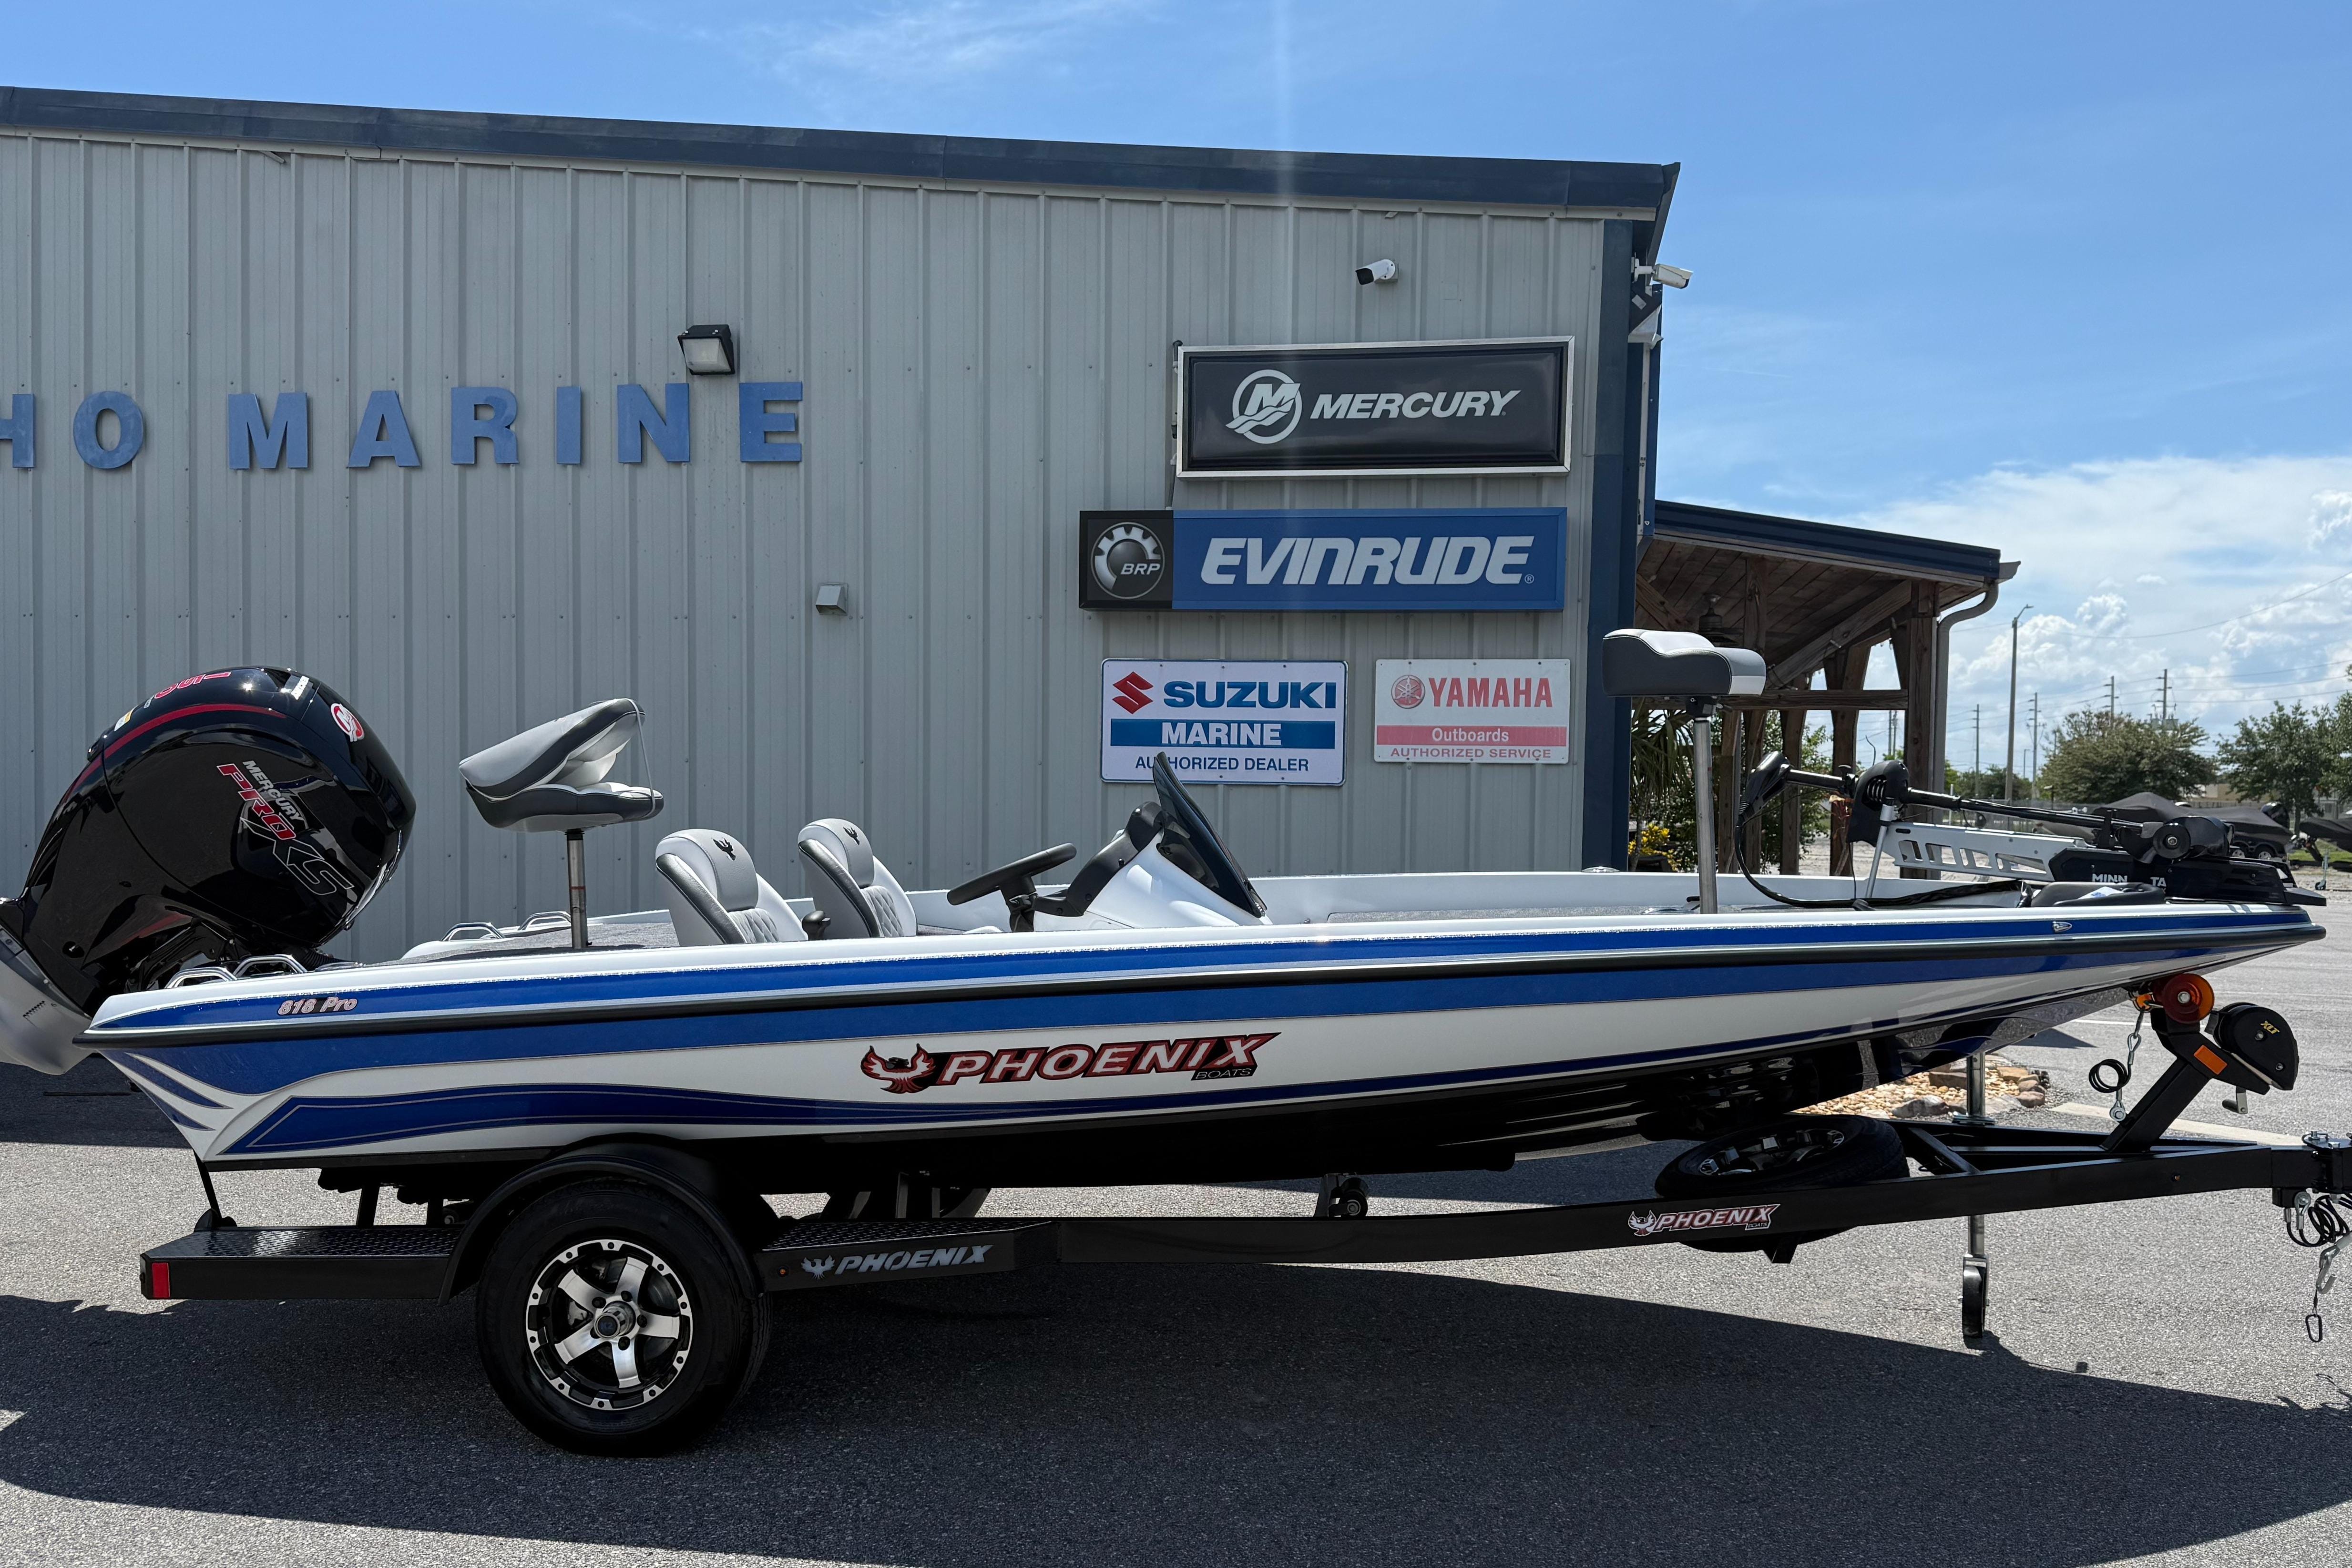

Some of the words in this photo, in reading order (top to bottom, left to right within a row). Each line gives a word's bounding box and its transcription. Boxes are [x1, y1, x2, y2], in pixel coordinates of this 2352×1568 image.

[1310, 390, 1522, 420] MERCURY
[228, 381, 803, 470] MARINE
[1121, 563, 1160, 575] BRP
[1163, 681, 1337, 709] SUZUKI
[1428, 677, 1553, 708] YAMAHA
[1161, 722, 1282, 746] MARINE
[1432, 727, 1510, 743] Outboards
[1135, 756, 1240, 771] AUHORIZED
[1244, 757, 1309, 771] DEALER
[1390, 747, 1486, 758] AUTHORIZED
[1488, 748, 1552, 759] SERVICE
[216, 763, 297, 840] PRO
[242, 760, 305, 822] MERCURY
[2092, 873, 2128, 882] MINN
[278, 999, 317, 1015] 818
[320, 996, 358, 1012] Pro
[2260, 1020, 2280, 1034] XLT
[935, 1033, 1280, 1085] PHOENIX
[1196, 1067, 1252, 1080] BOATS
[1656, 1205, 1779, 1231] PHOENIX
[834, 1245, 993, 1275] PHOENIX
